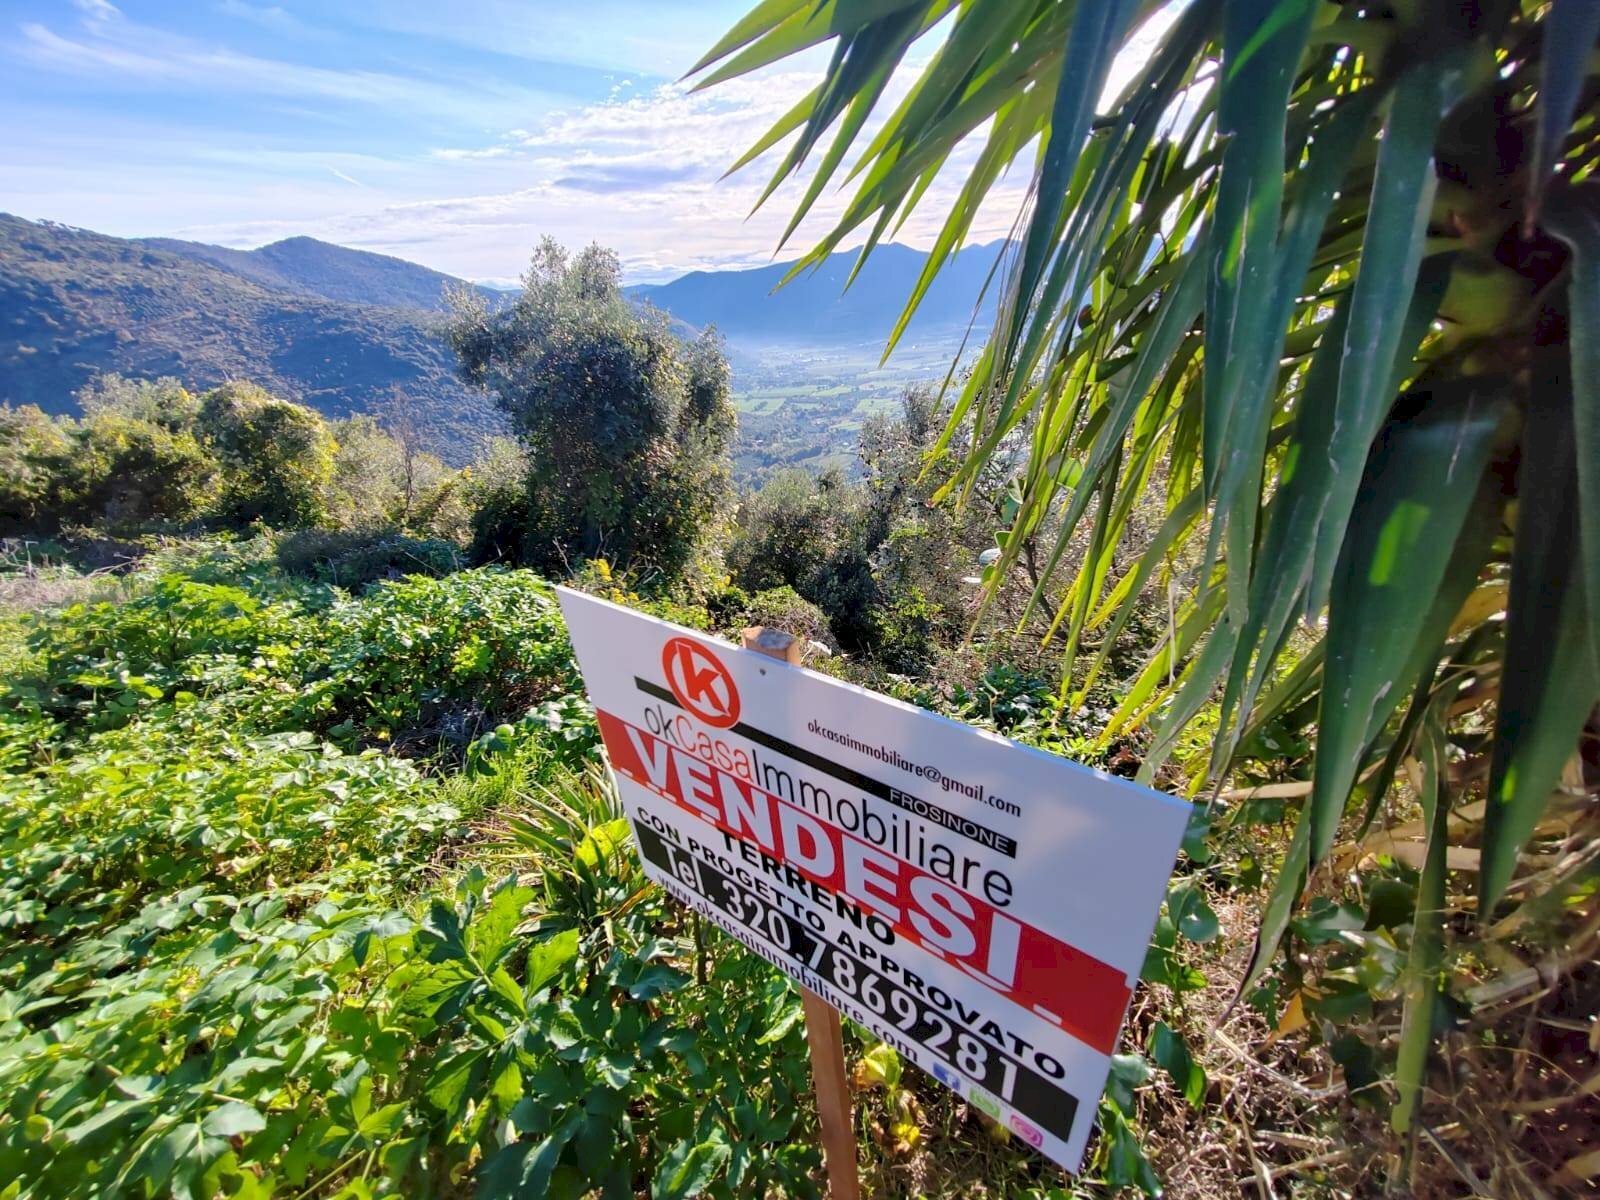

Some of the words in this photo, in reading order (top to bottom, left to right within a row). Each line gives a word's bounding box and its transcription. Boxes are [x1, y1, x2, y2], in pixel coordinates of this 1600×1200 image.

[624, 724, 1022, 988] VENDESI
[807, 719, 1021, 817] okcasaimmobiliare@gmail.com
[890, 789, 1009, 852] FROSINONE
[637, 806, 681, 844] CON
[688, 837, 825, 931] PROGETTO
[837, 930, 1066, 1079] APPROVATO
[657, 873, 918, 1062] www.okcasaimmobiliare.com
[660, 838, 715, 901] Tel.
[722, 879, 1018, 1102] 320.7869281
[717, 827, 895, 945] TERRENO
